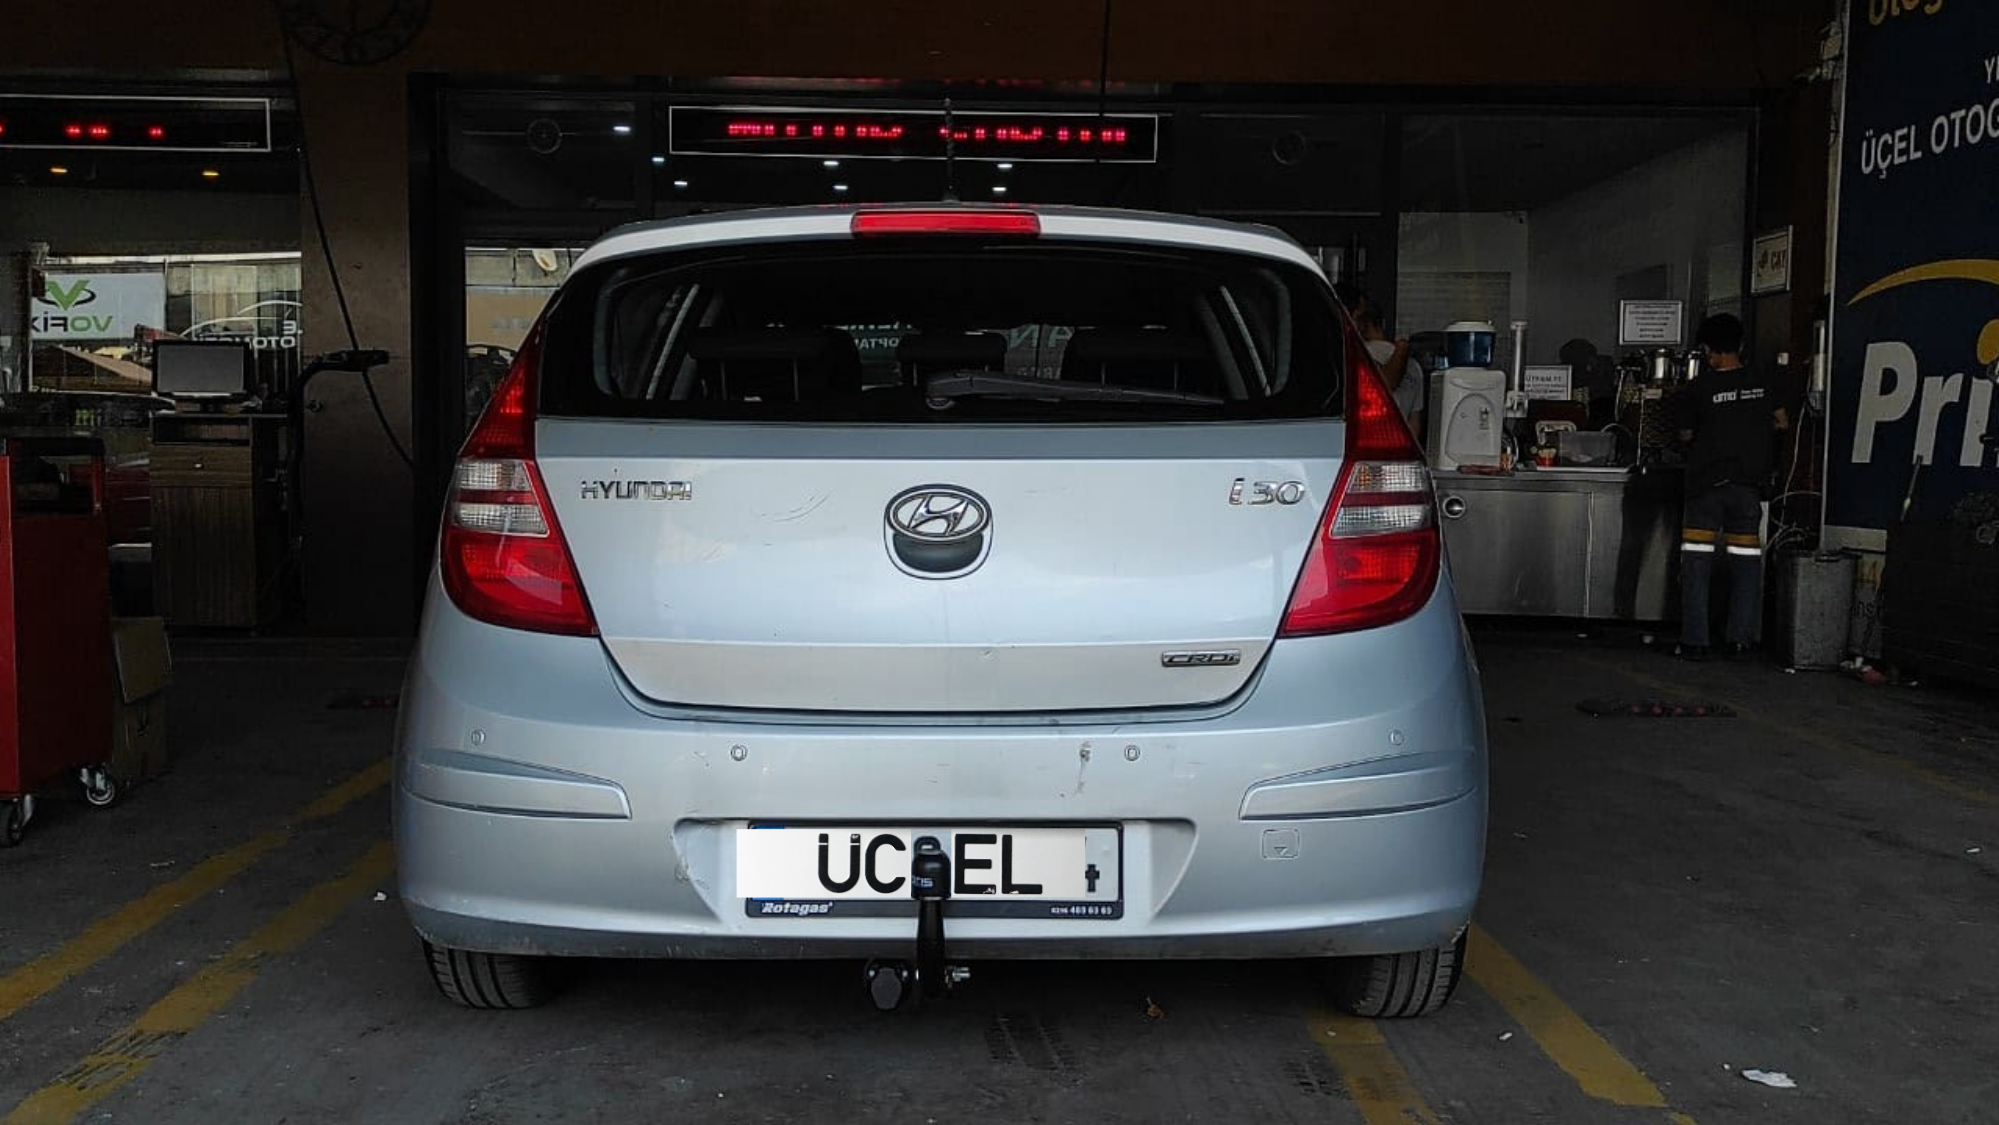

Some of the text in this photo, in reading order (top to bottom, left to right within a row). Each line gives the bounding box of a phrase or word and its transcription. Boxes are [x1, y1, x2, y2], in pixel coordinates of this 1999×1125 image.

[1861, 128, 1922, 179] ÜÇEL
[1851, 319, 1999, 468] Pri
[580, 480, 693, 501] HYUNDAI
[1228, 477, 1307, 506] i30
[761, 902, 832, 917] Rotagas
